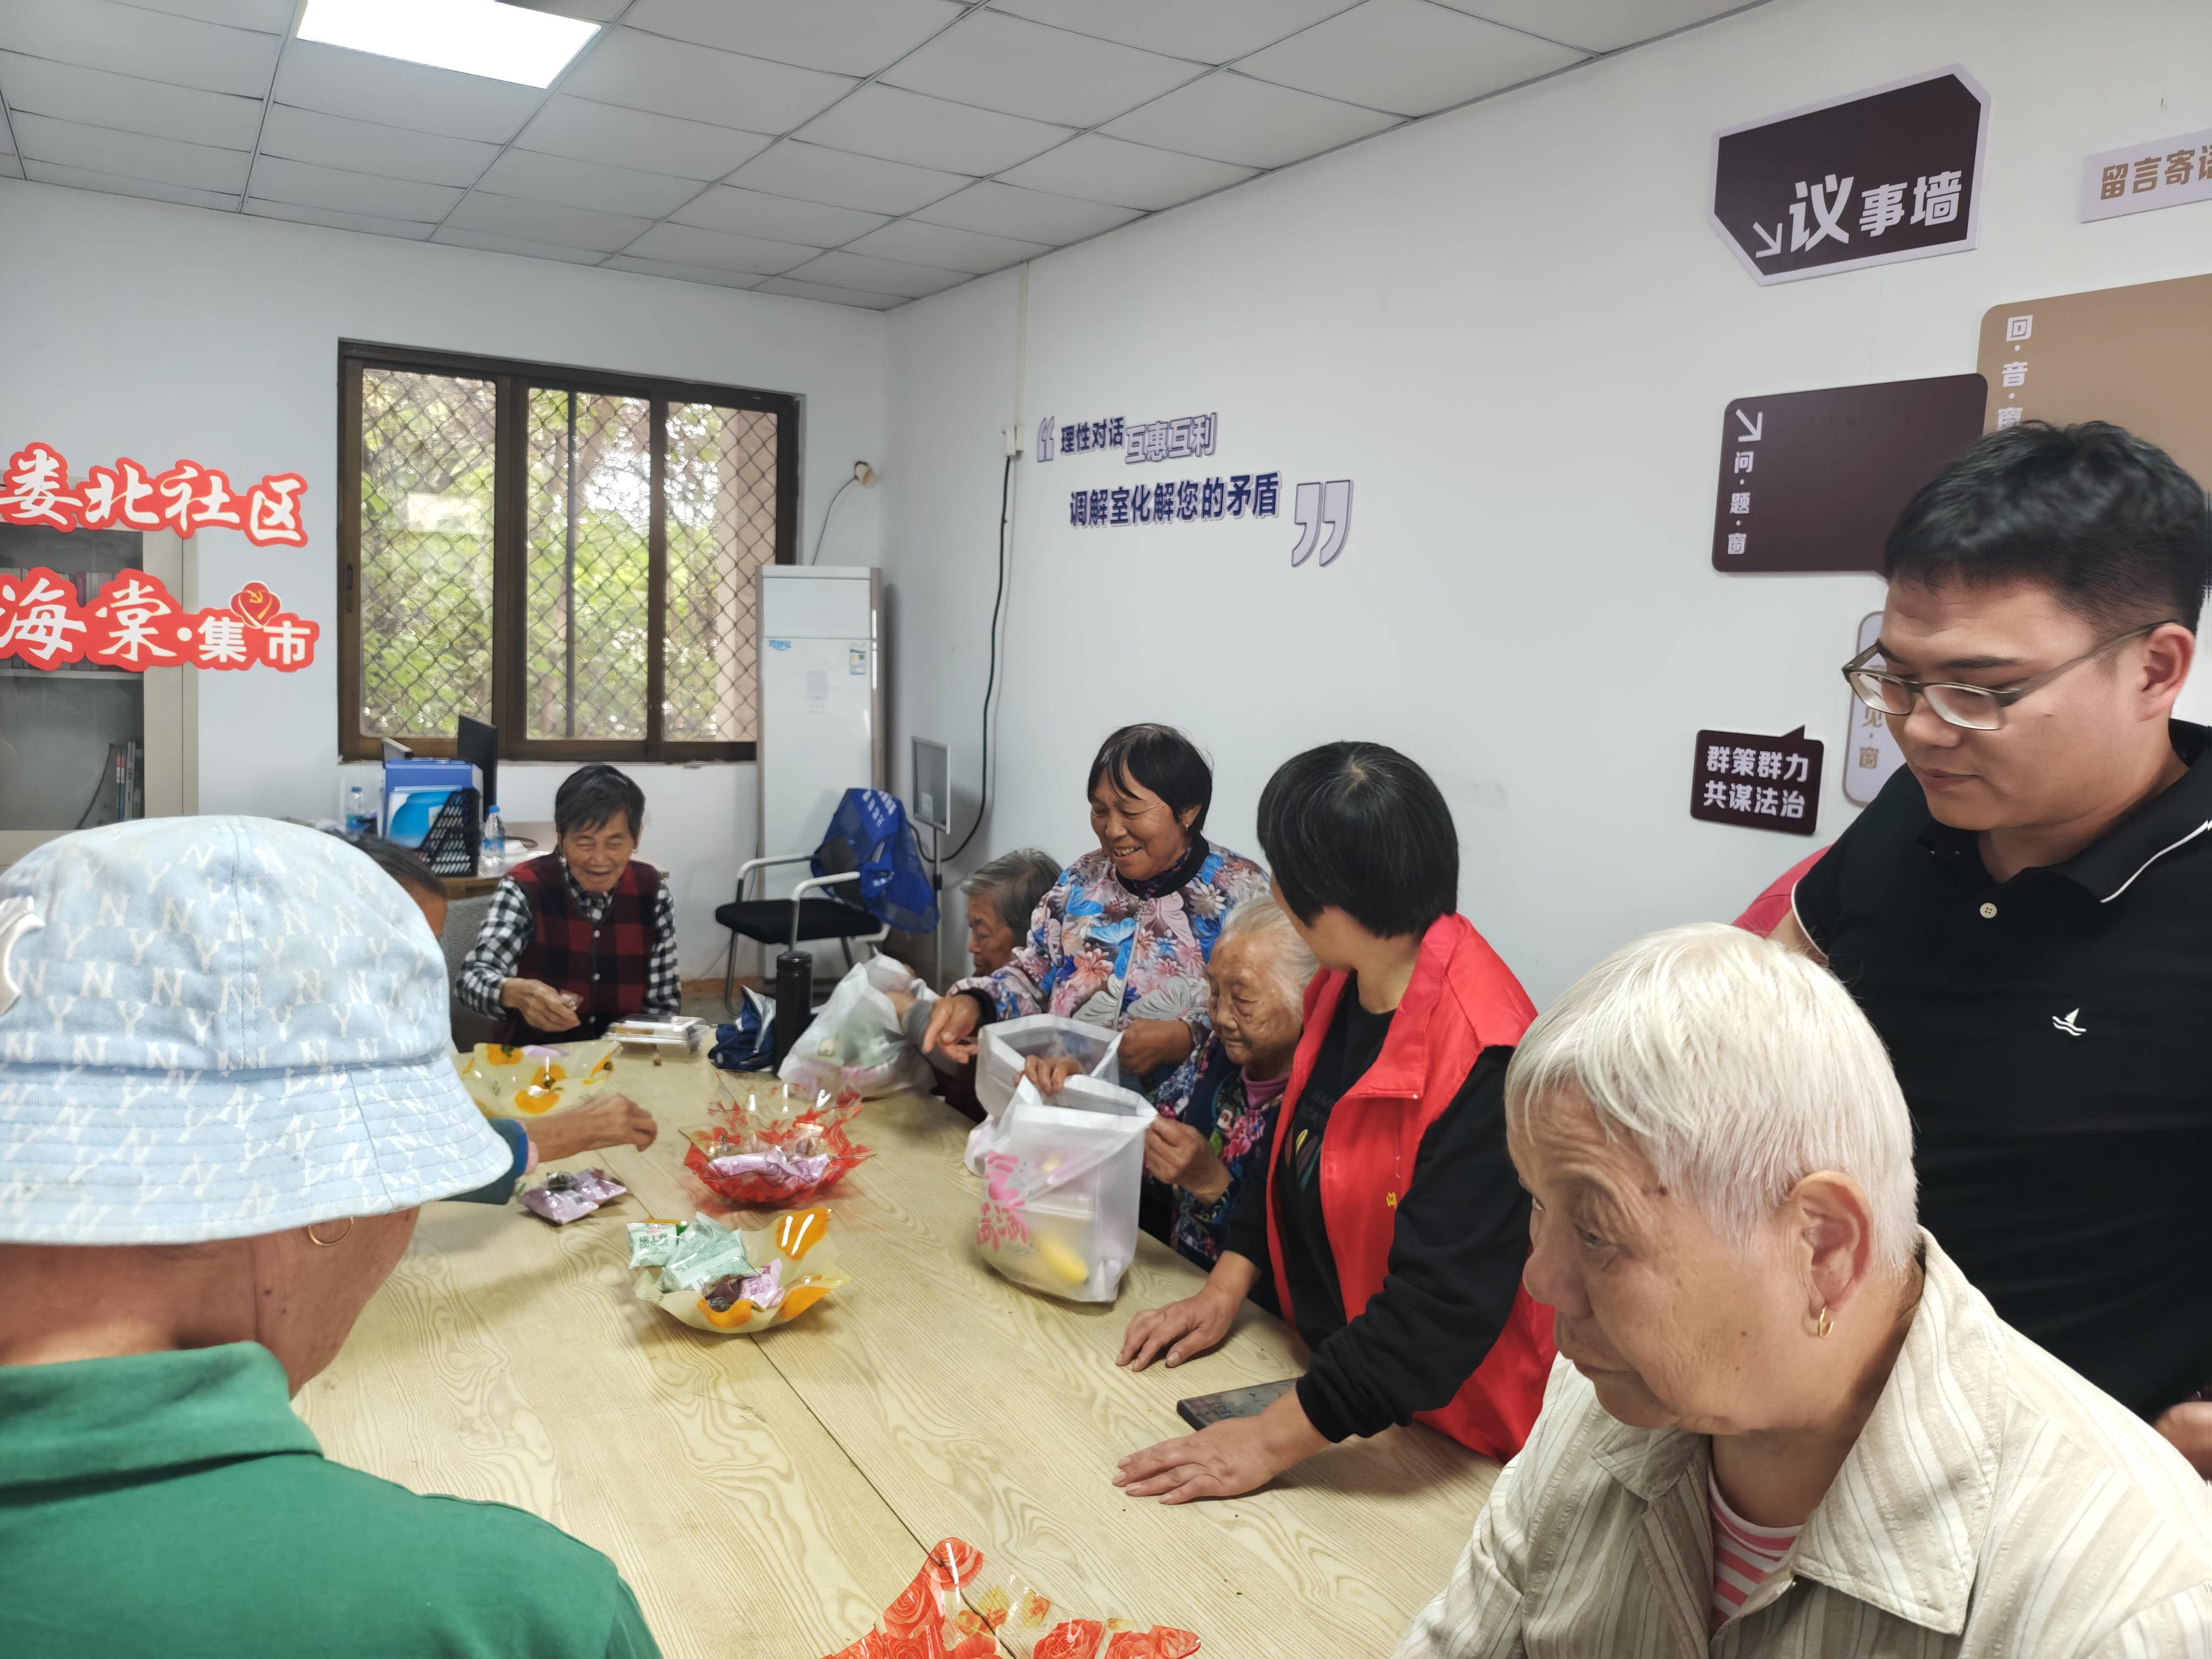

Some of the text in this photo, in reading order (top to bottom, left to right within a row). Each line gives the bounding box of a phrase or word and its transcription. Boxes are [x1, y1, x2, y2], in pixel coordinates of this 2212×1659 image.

[1789, 174, 1962, 252] 议事墙
[0, 449, 301, 540] 娄北社区
[1070, 470, 1282, 529] 调解室化解您的矛盾
[1707, 745, 1809, 783] 群策群力
[1703, 780, 1805, 819] 共谋法治
